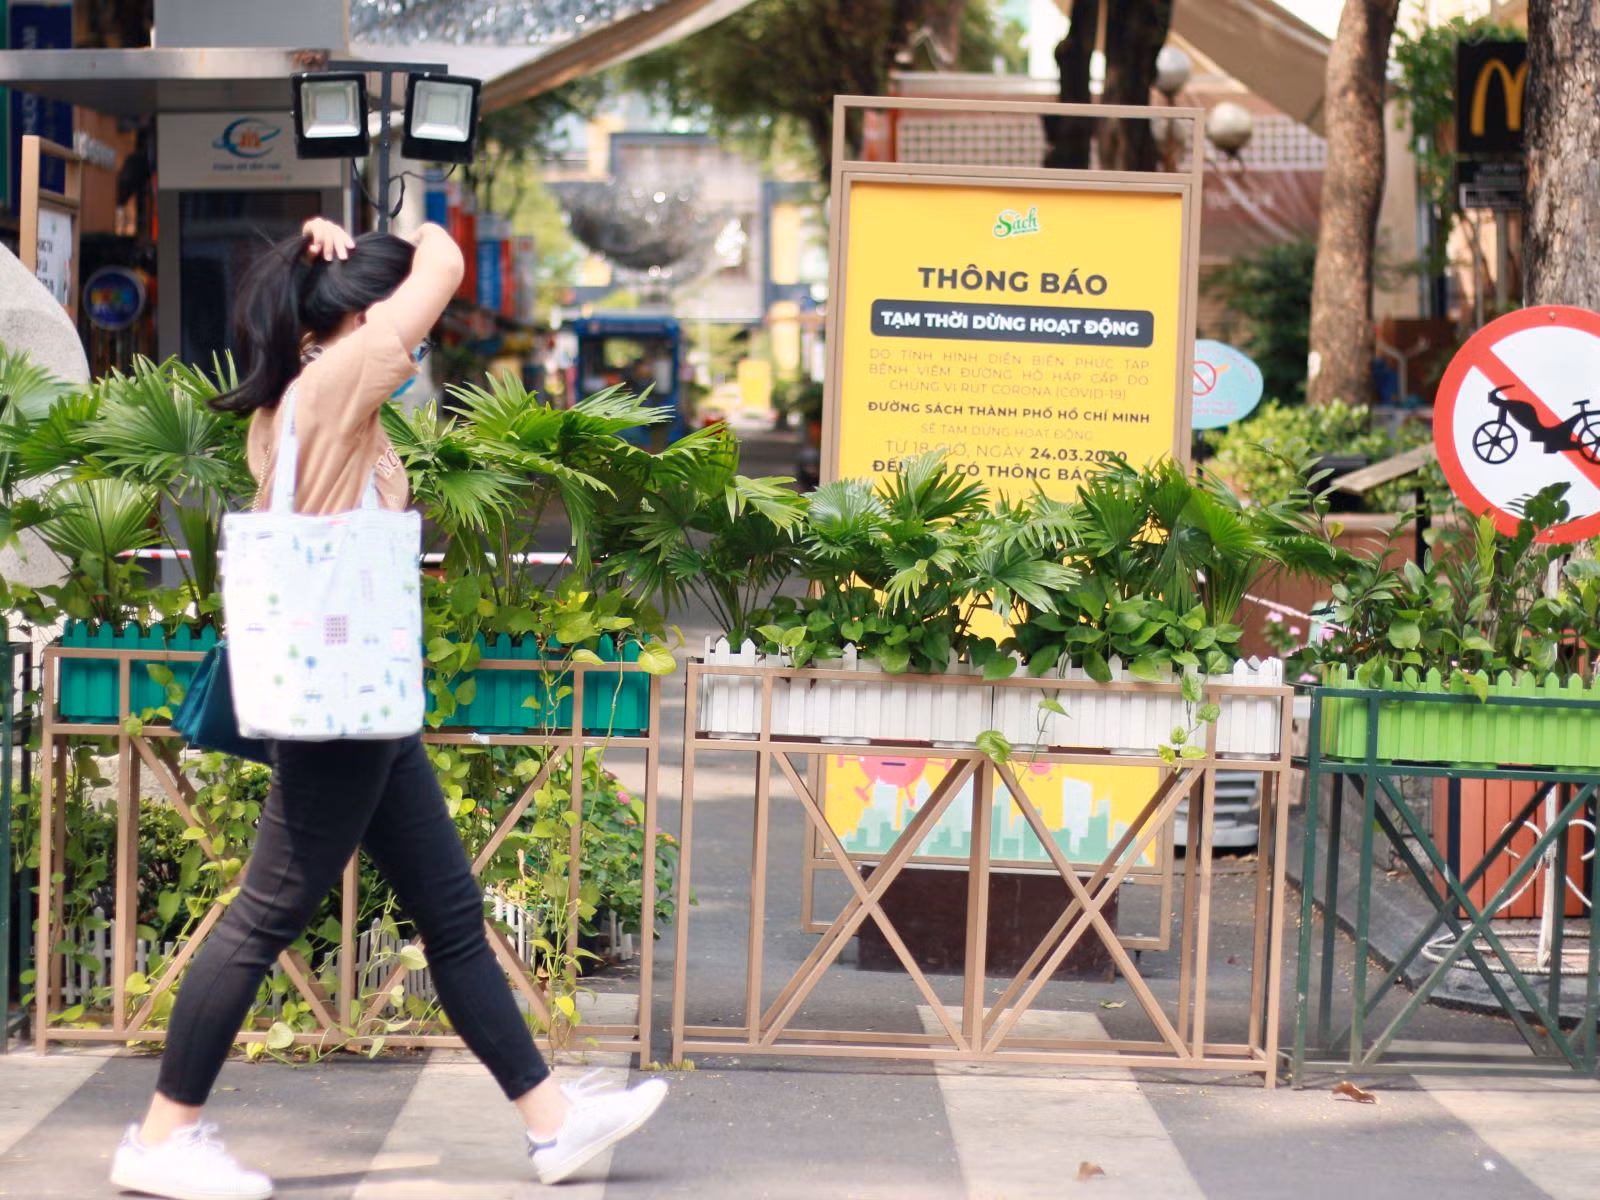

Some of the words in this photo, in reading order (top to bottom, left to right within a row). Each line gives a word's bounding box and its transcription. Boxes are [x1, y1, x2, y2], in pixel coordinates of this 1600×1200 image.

[918, 264, 1029, 293] THÔNG
[1040, 268, 1108, 296] BÁO
[880, 311, 921, 329] TẠM
[924, 311, 968, 329] THỜI
[972, 313, 1027, 332] DỪNG
[1029, 318, 1081, 337] HOẠT
[1083, 318, 1140, 338] ĐỘNG
[869, 348, 891, 359] DO
[1127, 374, 1149, 386] DO
[991, 384, 1052, 397] CORONA
[868, 400, 920, 413] ĐƯỜNG
[925, 402, 963, 415] SÁCH
[968, 404, 1017, 417] THÀNH
[1023, 405, 1053, 419] PHỐ
[1083, 410, 1108, 422] CHÍ
[1112, 412, 1150, 423] MINH
[1030, 447, 1127, 463] 24.03.200
[986, 463, 1051, 480] THÔNG
